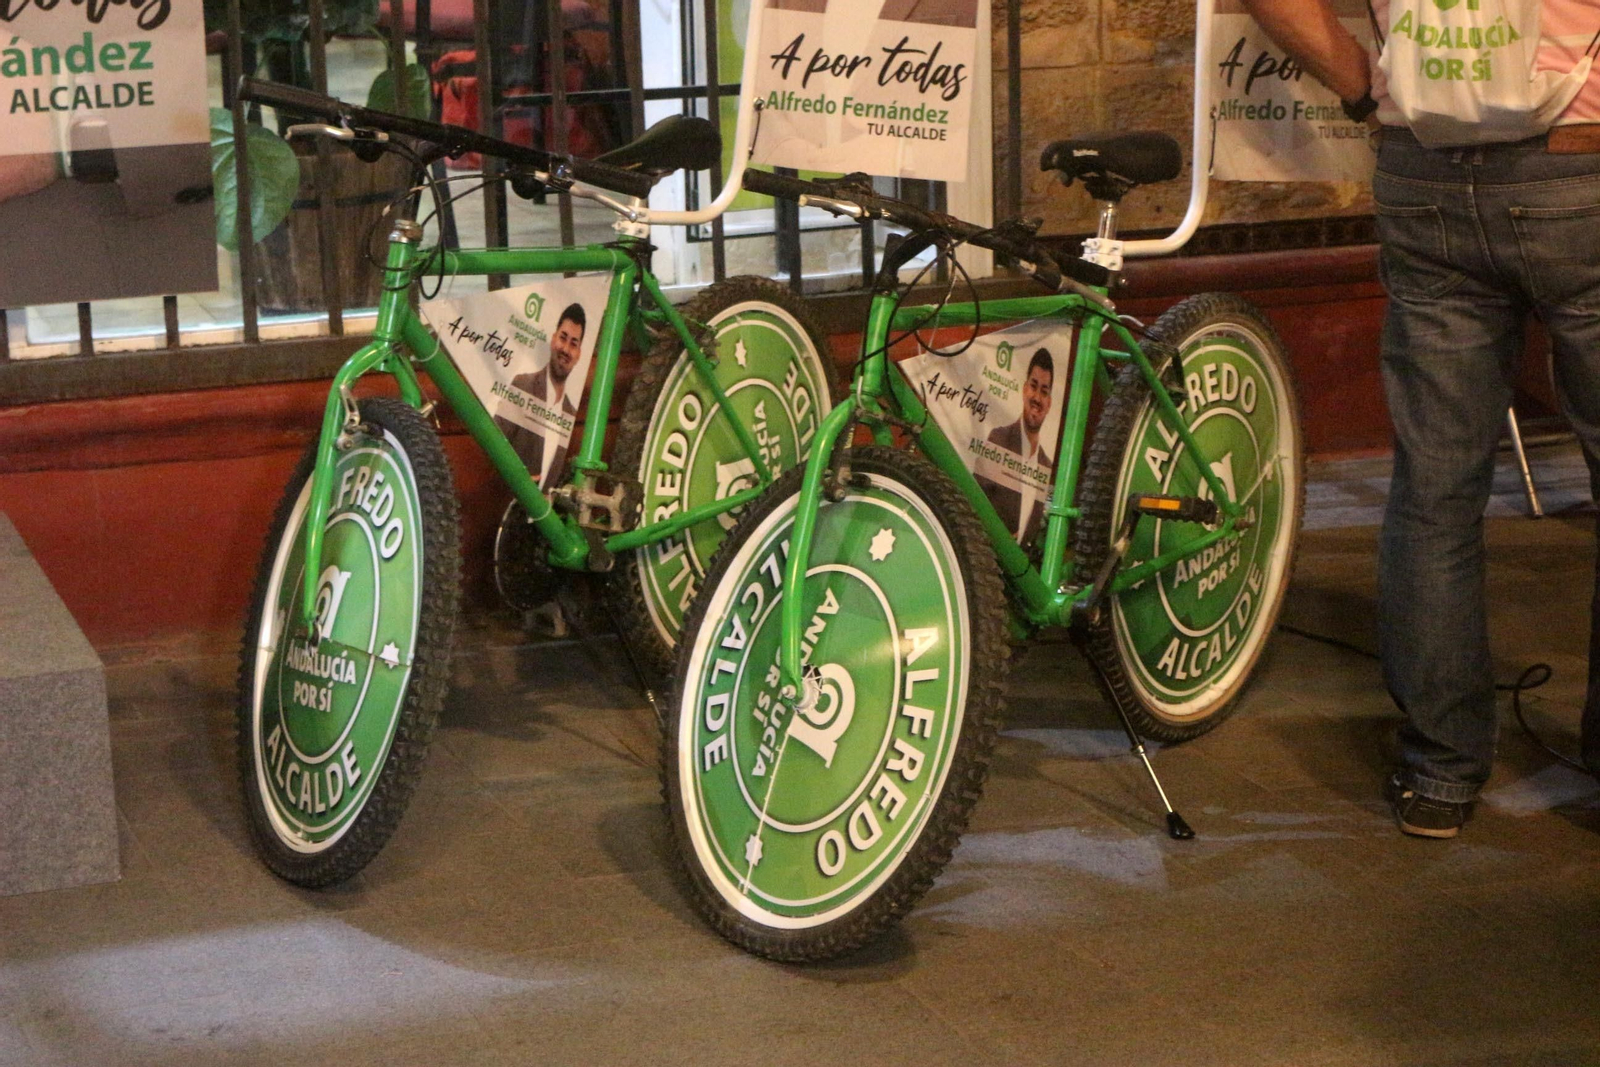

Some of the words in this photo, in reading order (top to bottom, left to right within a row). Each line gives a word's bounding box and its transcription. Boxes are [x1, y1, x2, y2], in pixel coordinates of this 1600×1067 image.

[1392, 10, 1521, 49] ADALUCÍA
[770, 33, 805, 80] A
[802, 48, 872, 89] por
[878, 36, 967, 101] todas
[1218, 36, 1246, 88] A
[1420, 57, 1464, 81] OR
[10, 81, 155, 114] ALCALDE
[765, 90, 837, 115] Alfredo
[842, 96, 949, 125] Fernández
[1217, 99, 1286, 121] Alfredo
[867, 122, 882, 136] TU
[887, 124, 947, 141] ALCALDE
[449, 316, 463, 337] A
[457, 326, 484, 344] por
[483, 330, 513, 367] todas
[514, 332, 527, 345] POR
[927, 372, 940, 394] A
[935, 382, 960, 402] por
[960, 384, 989, 422] todas
[982, 365, 1019, 392] ANDALUCÍA
[989, 384, 1002, 397] POR
[491, 380, 525, 407] Alfredo
[526, 398, 572, 431] Fernández
[1144, 362, 1256, 483] ALREDO
[968, 437, 1001, 463] Alfredo
[1002, 452, 1048, 484] Fernández
[329, 466, 404, 559] FREDO
[1198, 561, 1227, 599] POR
[1157, 563, 1263, 680] ALCALDE
[285, 639, 357, 684] ANDALUCÍA
[293, 680, 318, 709] POR
[318, 681, 335, 713] SÍ
[267, 724, 361, 814] ALCALDE
[817, 626, 939, 876] ALFREDO
